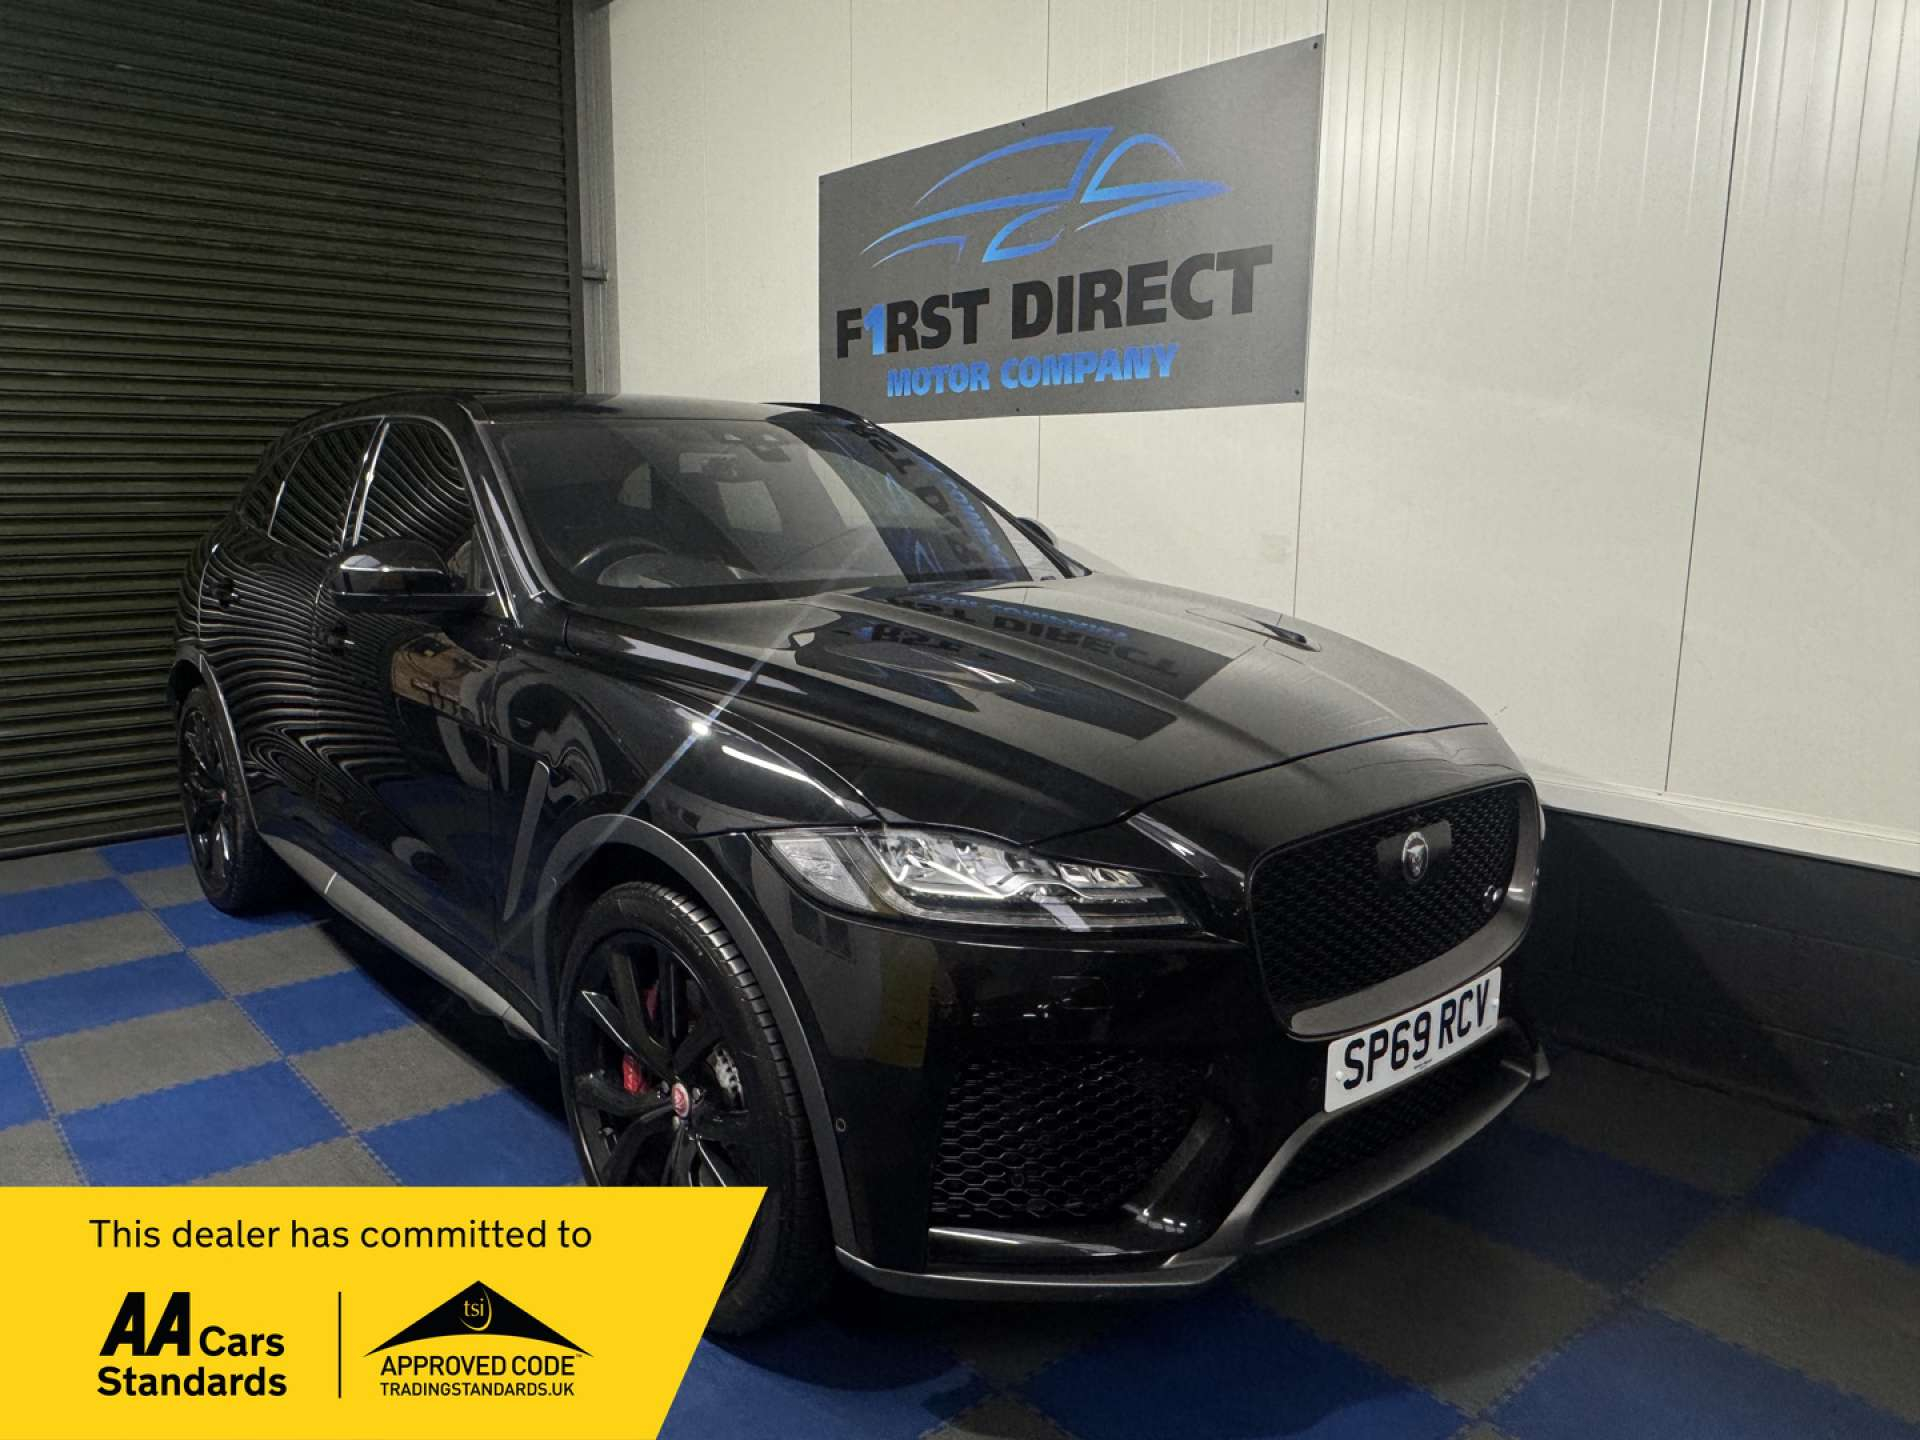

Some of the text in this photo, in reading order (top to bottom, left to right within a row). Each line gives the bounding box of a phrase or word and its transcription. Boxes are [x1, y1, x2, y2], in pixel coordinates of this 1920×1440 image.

[1011, 244, 1273, 340] DIRECT
[887, 342, 1181, 397] MOTOR COMPANY
[1343, 979, 1490, 1090] SP69 RCV
